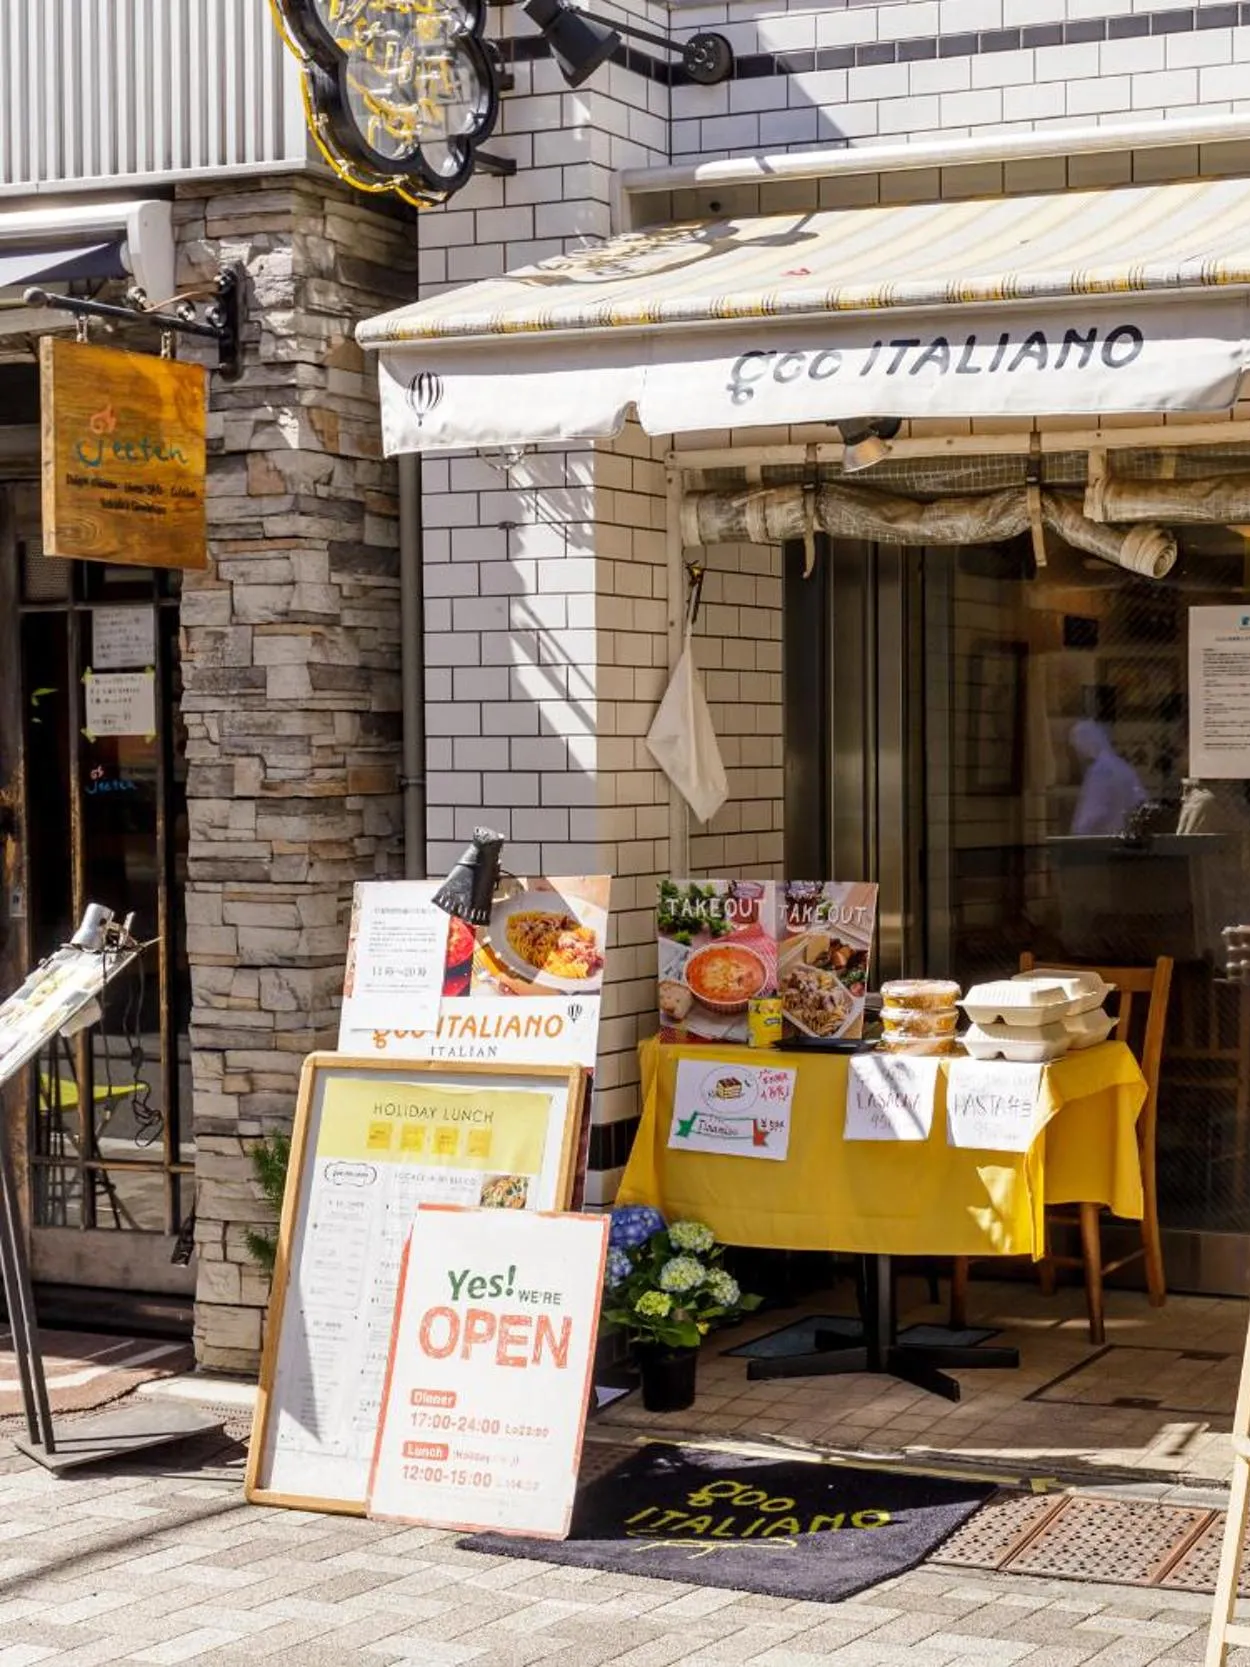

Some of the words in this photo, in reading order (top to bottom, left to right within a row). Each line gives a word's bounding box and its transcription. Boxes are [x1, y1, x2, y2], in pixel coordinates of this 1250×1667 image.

[860, 325, 1144, 376] ITALIANO
[666, 898, 767, 919] TAKEOUT
[778, 903, 867, 924] TAKEOUT
[434, 1014, 564, 1039] ITALIANO
[430, 1046, 498, 1058] ITALIAN
[373, 1103, 437, 1120] HOLIDAY
[443, 1107, 494, 1123] LUNCH
[448, 1265, 516, 1301] Yes!
[518, 1290, 562, 1306] WE'RE
[419, 1306, 573, 1369] OPEN
[412, 1390, 449, 1405] Dinner
[410, 1411, 500, 1436] 17:00-24:00
[407, 1443, 443, 1458] Lunch
[402, 1464, 492, 1489] 12:00-15:00
[625, 1507, 892, 1538] ITALIANO
